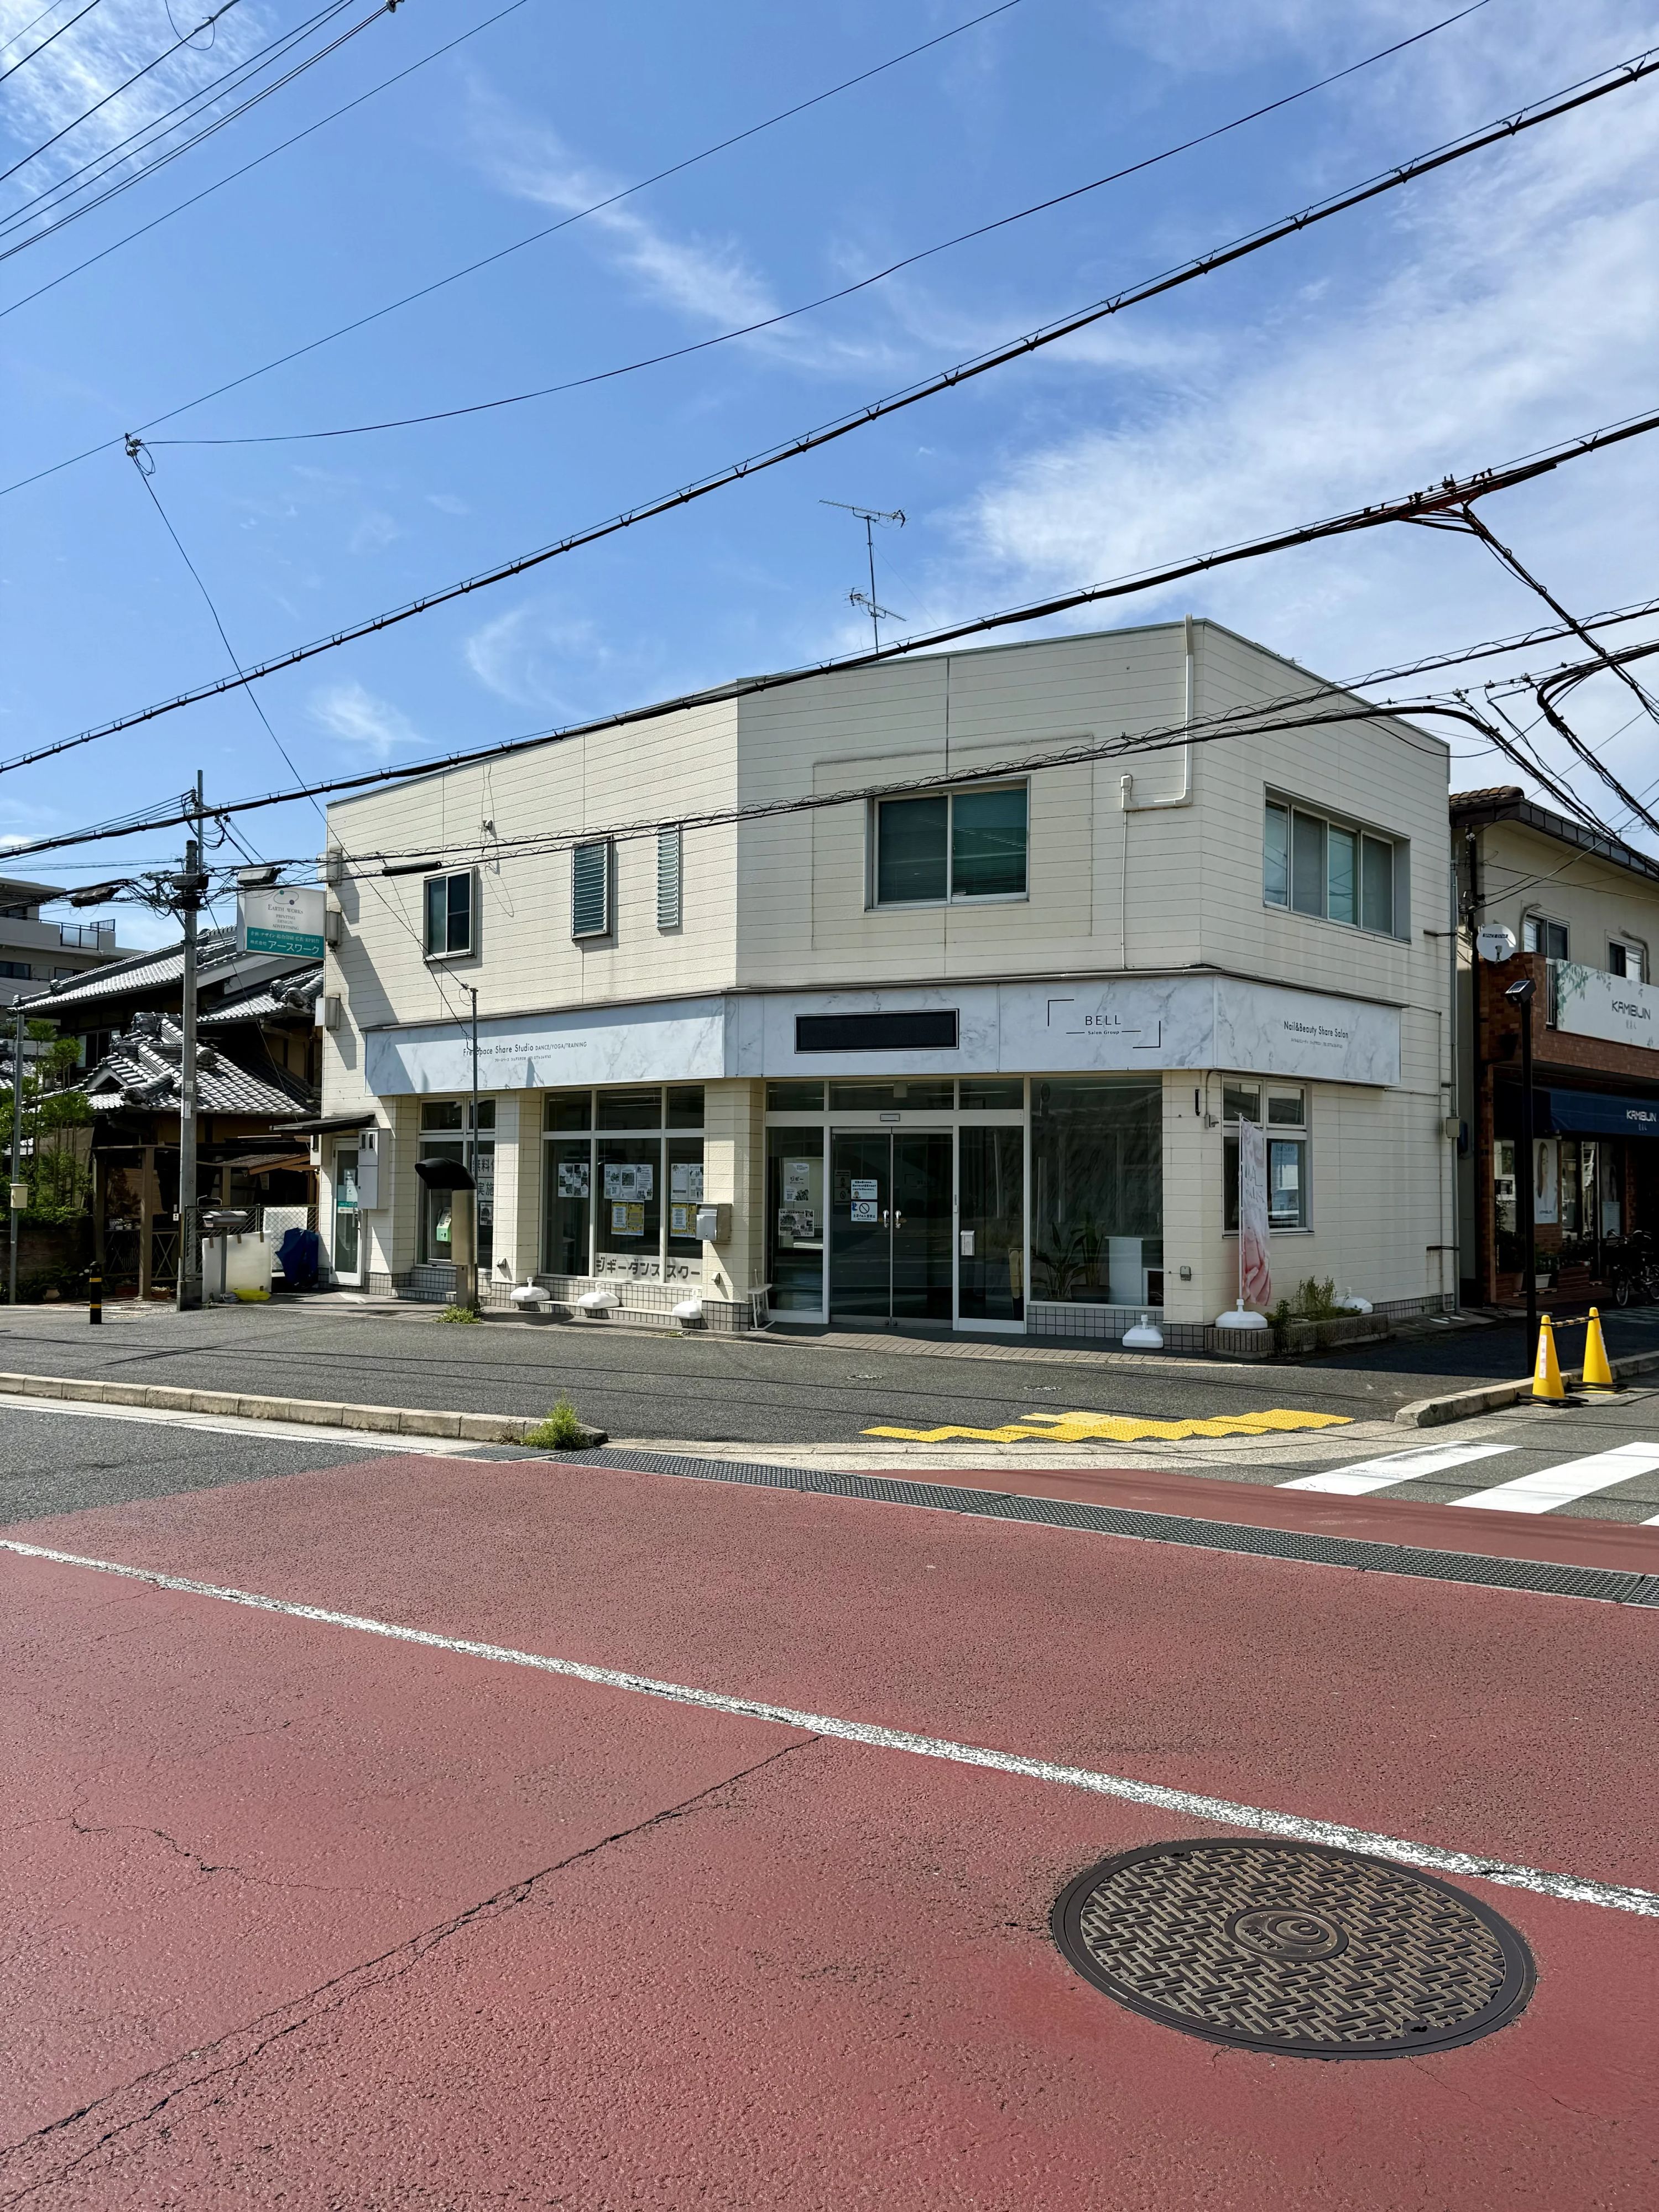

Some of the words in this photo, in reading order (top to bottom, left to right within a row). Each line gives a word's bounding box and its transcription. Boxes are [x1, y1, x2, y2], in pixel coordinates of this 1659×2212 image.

[268, 940, 320, 954] アースワーク
[1085, 1015, 1121, 1026] BELL
[1284, 1020, 1317, 1037] Nail&Beauty
[1318, 1025, 1333, 1036] Share
[1334, 1028, 1348, 1039] Salon
[495, 1045, 512, 1054] Share
[514, 1043, 534, 1053] Studio
[535, 1041, 587, 1051] DANCE/YOGA/TRAINING
